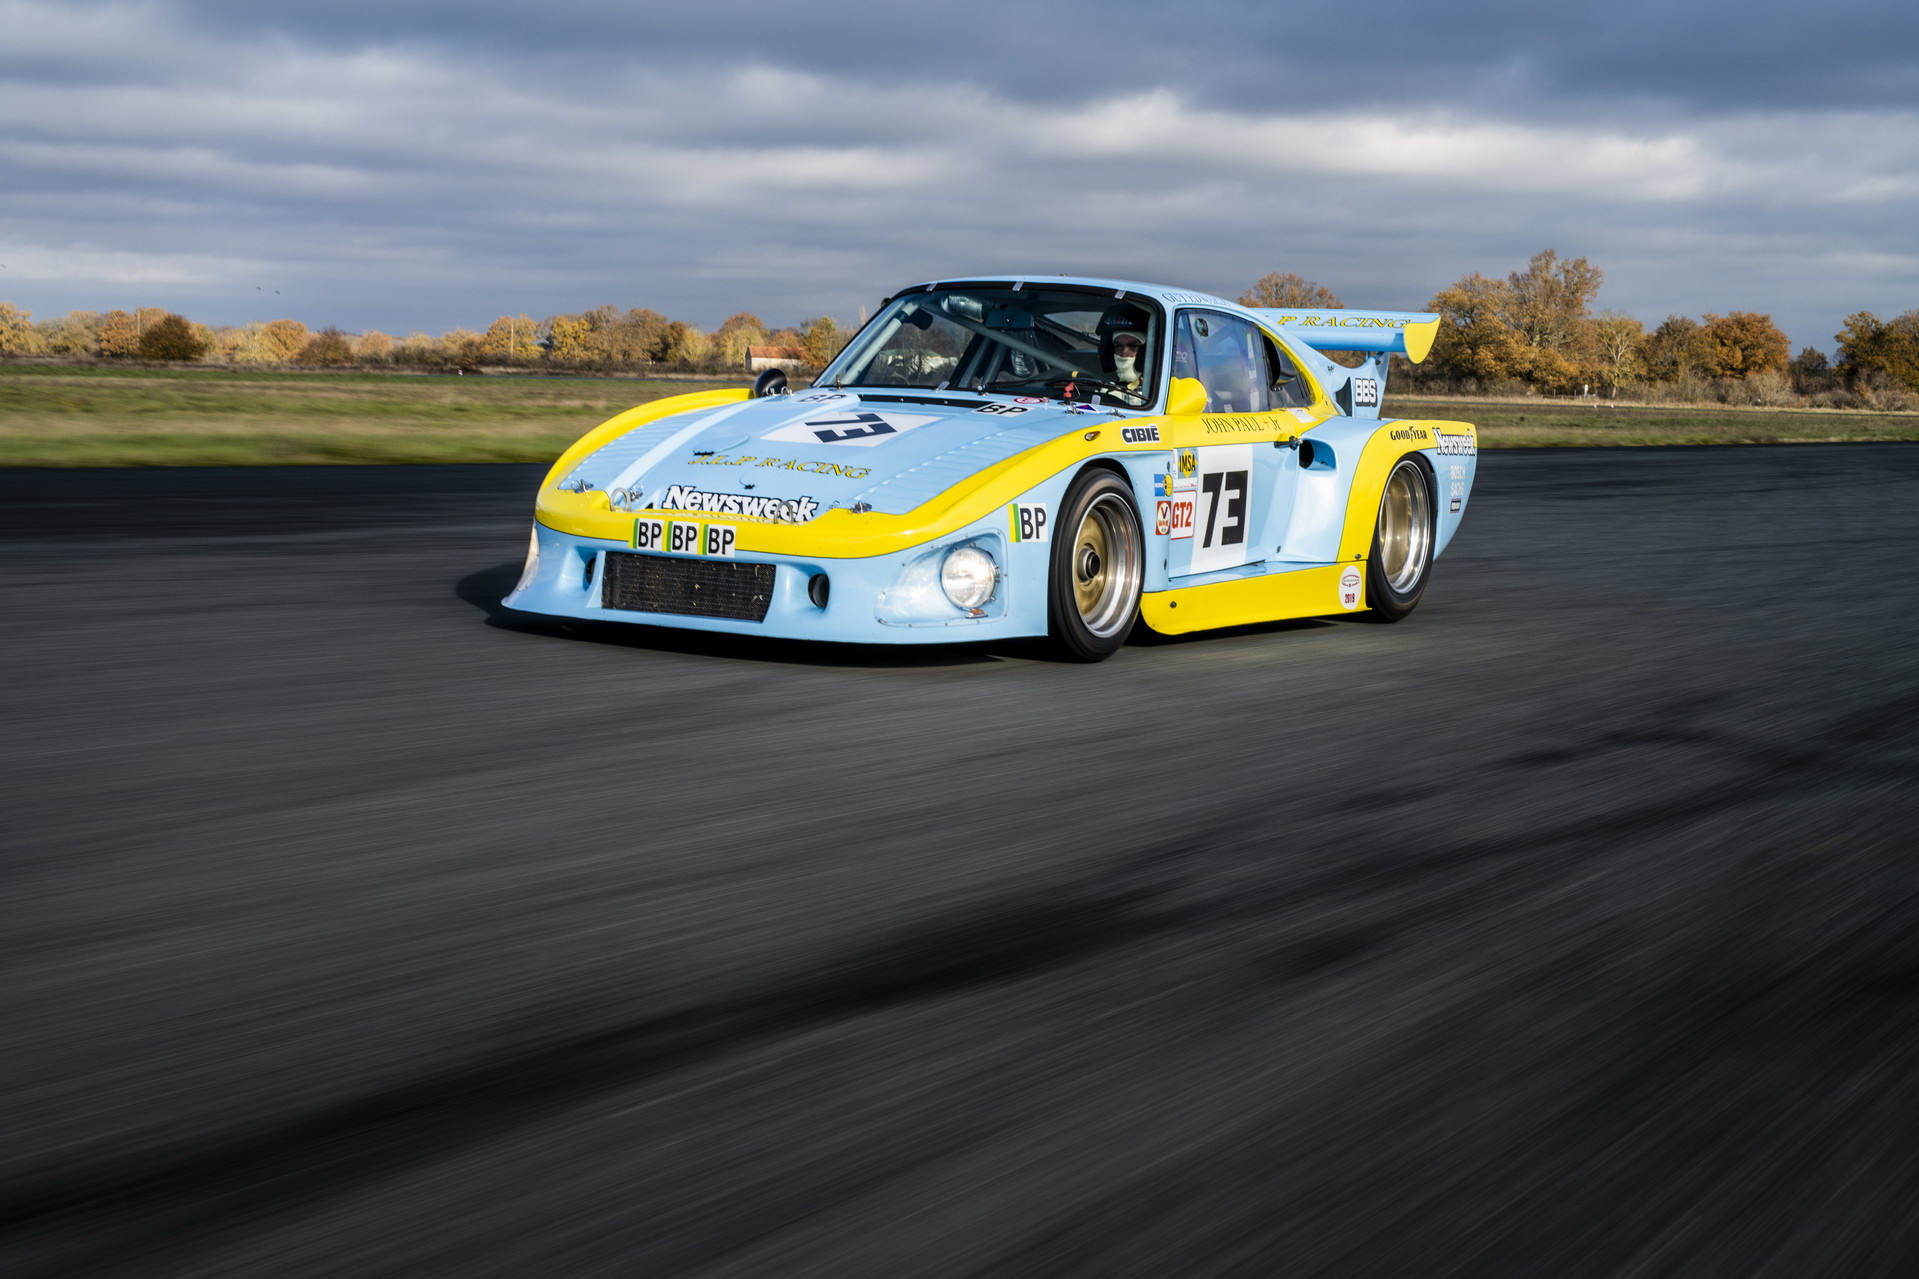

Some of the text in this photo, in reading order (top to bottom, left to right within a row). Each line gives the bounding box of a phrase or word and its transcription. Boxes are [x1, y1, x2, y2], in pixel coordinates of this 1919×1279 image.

[1298, 316, 1411, 329] RACING
[797, 394, 848, 402] BP
[1355, 378, 1377, 407] BBS
[975, 404, 1028, 414] BP
[1201, 417, 1236, 434] JOHN
[1235, 416, 1265, 433] PAUL
[1432, 427, 1476, 456] Newsweek
[754, 457, 872, 479] RACING
[1180, 454, 1196, 473] IMSA
[662, 485, 820, 522] Newsweek
[1172, 501, 1193, 529] GT2
[1202, 470, 1248, 548] 73
[1019, 507, 1047, 540] BP
[637, 522, 735, 555] BP BP BP
